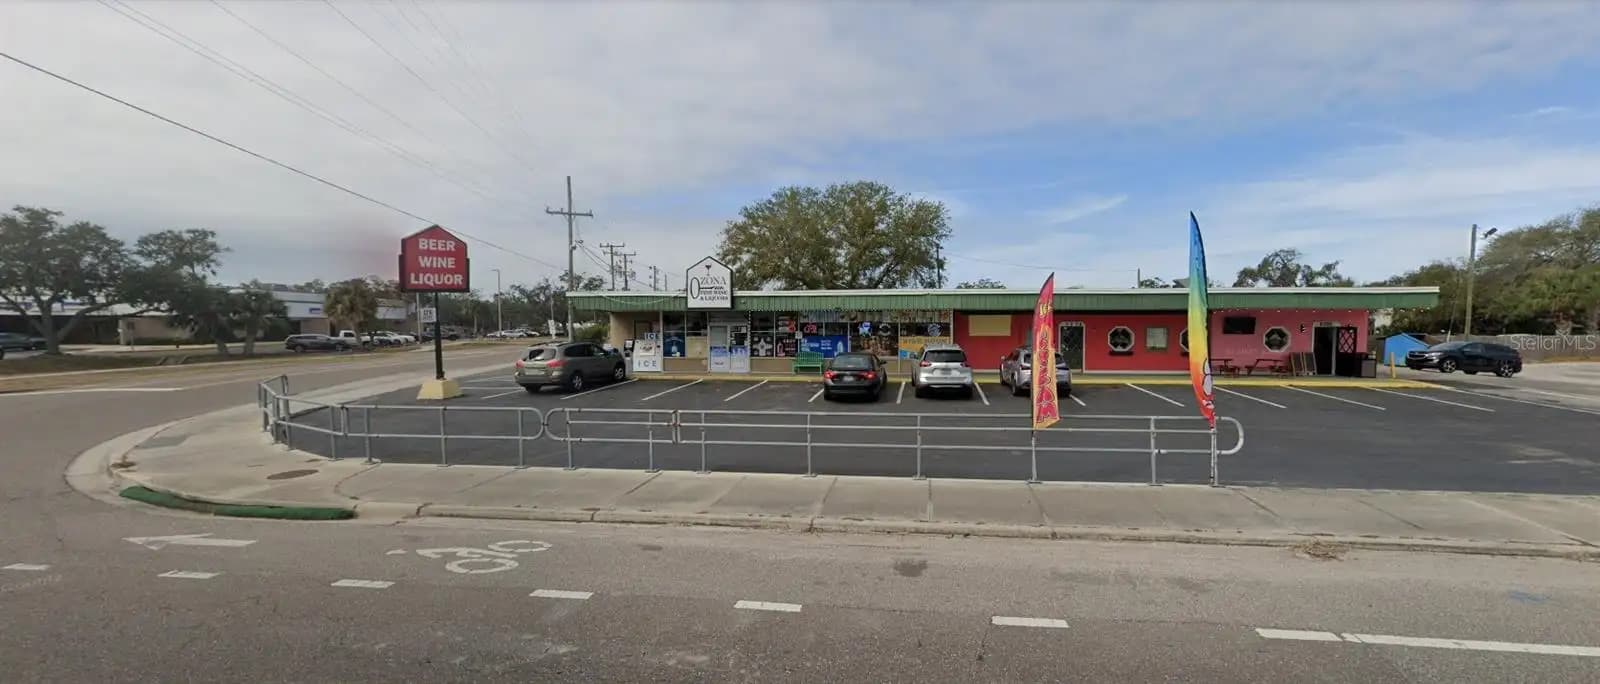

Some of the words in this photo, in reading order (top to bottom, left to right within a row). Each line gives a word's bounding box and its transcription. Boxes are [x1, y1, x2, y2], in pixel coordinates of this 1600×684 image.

[418, 239, 456, 251] BEER
[418, 256, 456, 268] WINE
[410, 273, 464, 287] LIQUOR
